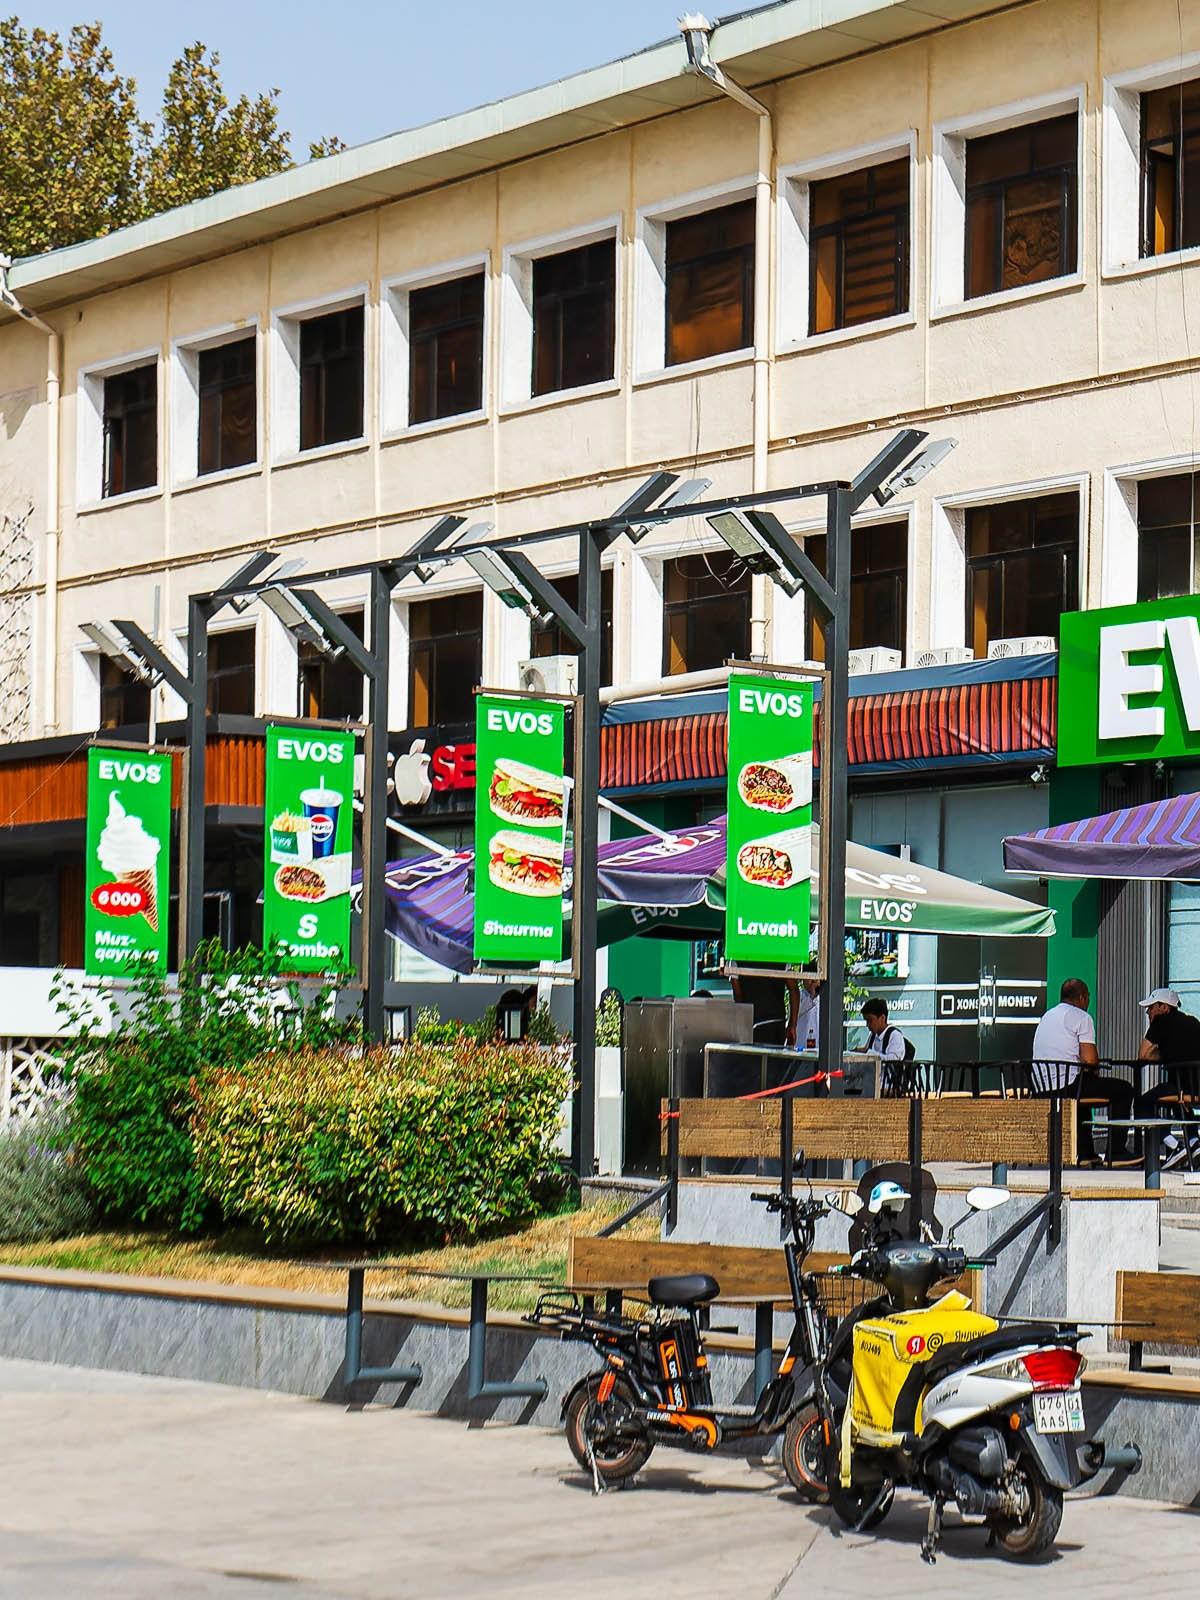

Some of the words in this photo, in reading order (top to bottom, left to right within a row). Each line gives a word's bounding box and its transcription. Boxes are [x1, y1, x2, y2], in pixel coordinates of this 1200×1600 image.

[739, 689, 803, 718] EVOS
[487, 709, 553, 735] EVOS
[277, 739, 343, 764] EVOS
[98, 760, 161, 784] EVOS
[860, 900, 914, 923] EVOS
[95, 930, 136, 946] Muz-
[298, 914, 318, 939] S
[482, 920, 553, 938] Shaurma
[737, 918, 798, 937] Lavash
[998, 995, 1037, 1008] MONEY
[1041, 1415, 1065, 1429] AAS
